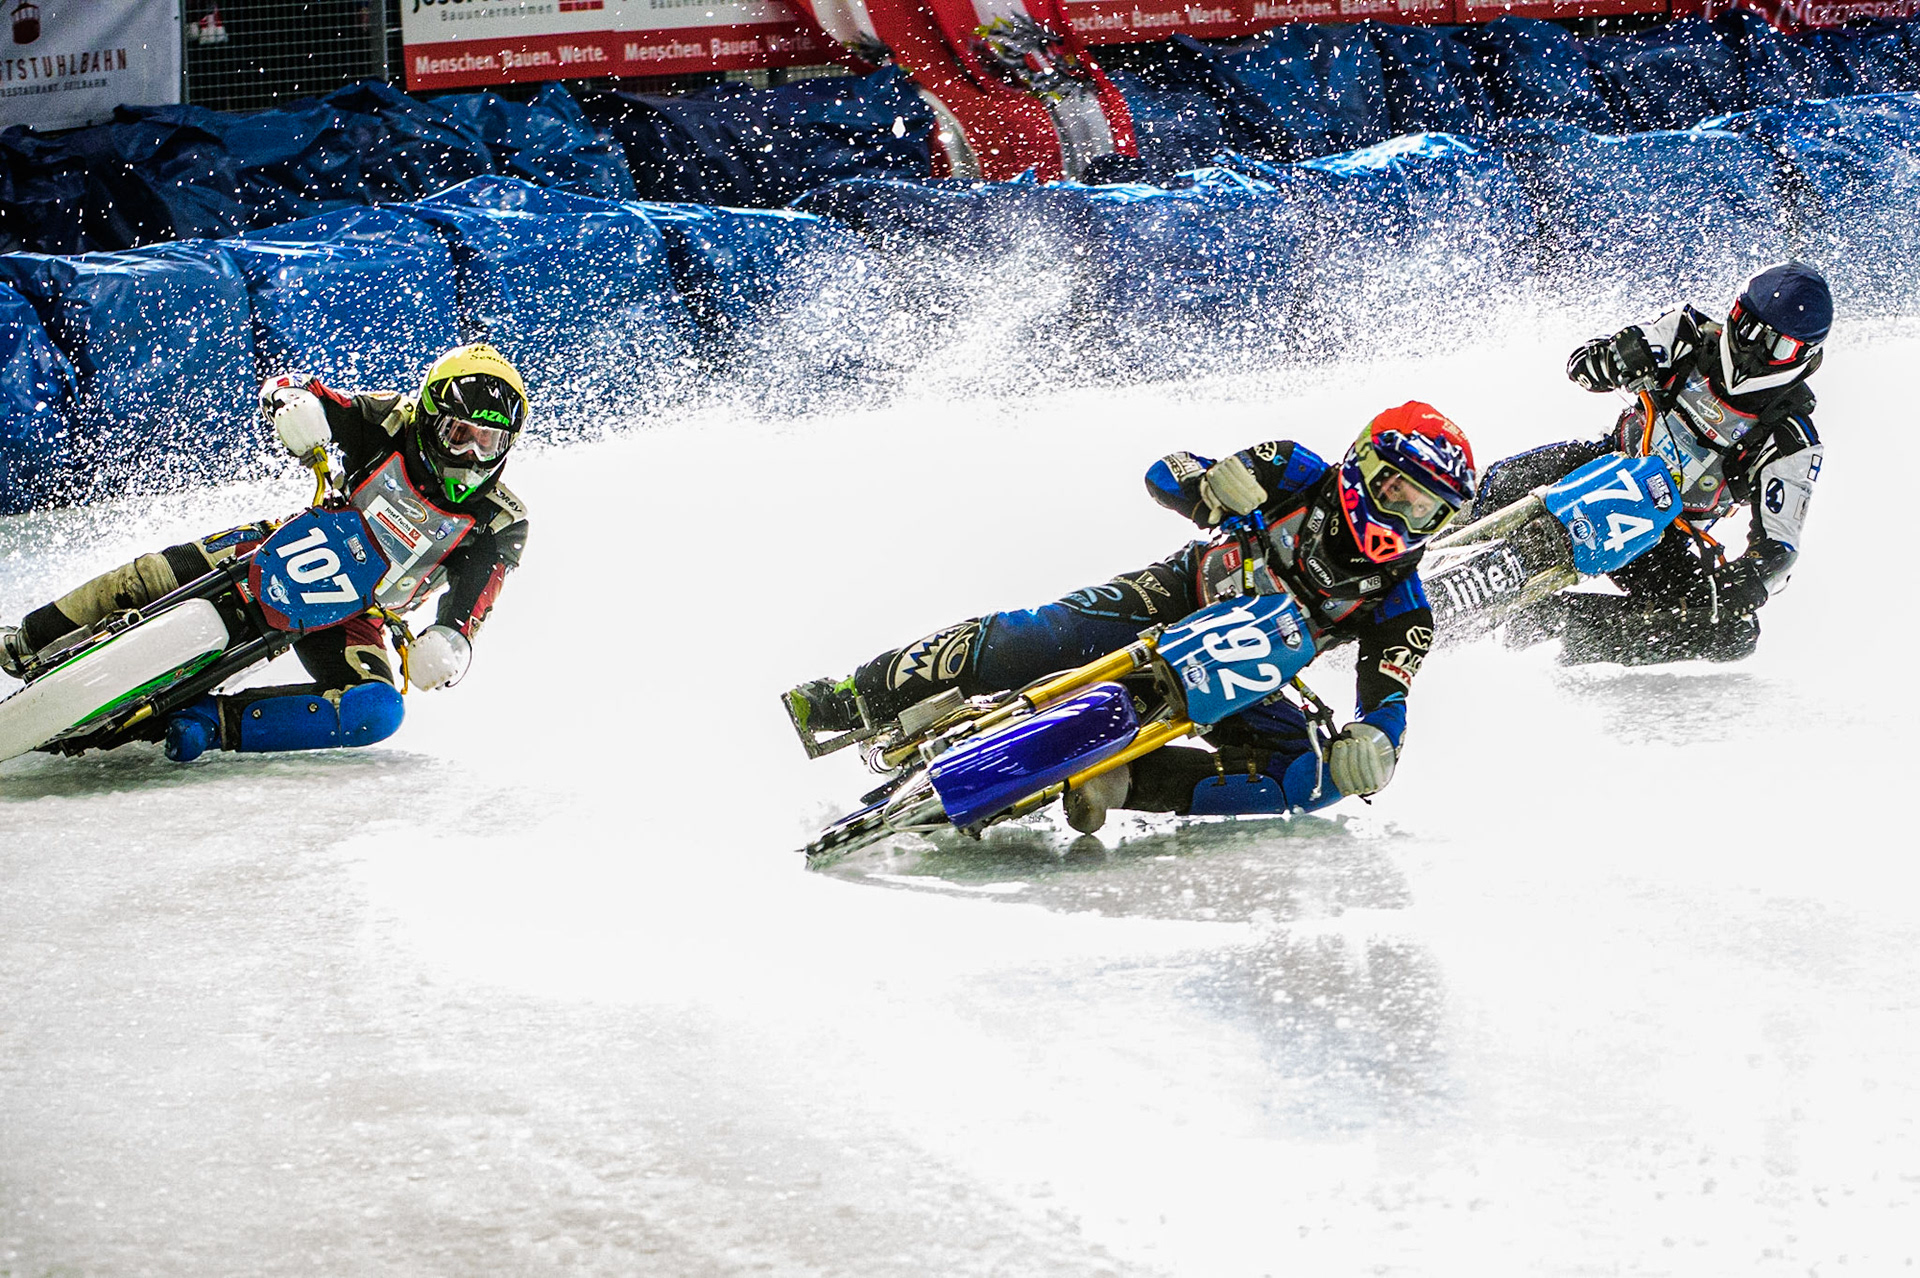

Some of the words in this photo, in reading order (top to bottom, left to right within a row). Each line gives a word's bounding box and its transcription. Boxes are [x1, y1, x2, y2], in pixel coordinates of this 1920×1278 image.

[1132, 11, 1185, 27] Bauen.
[1188, 8, 1237, 24] Werte.
[0, 48, 127, 80] TSTUHLBAHN
[415, 53, 499, 74] Menschen.
[503, 49, 556, 68] Bauen.
[558, 45, 608, 63] Werte.
[624, 41, 707, 61] Menschen.
[711, 37, 763, 55] Bauen.
[471, 409, 510, 427] LAZER
[1581, 468, 1654, 553] 74
[275, 526, 360, 604] 107
[1190, 606, 1283, 701] 192
